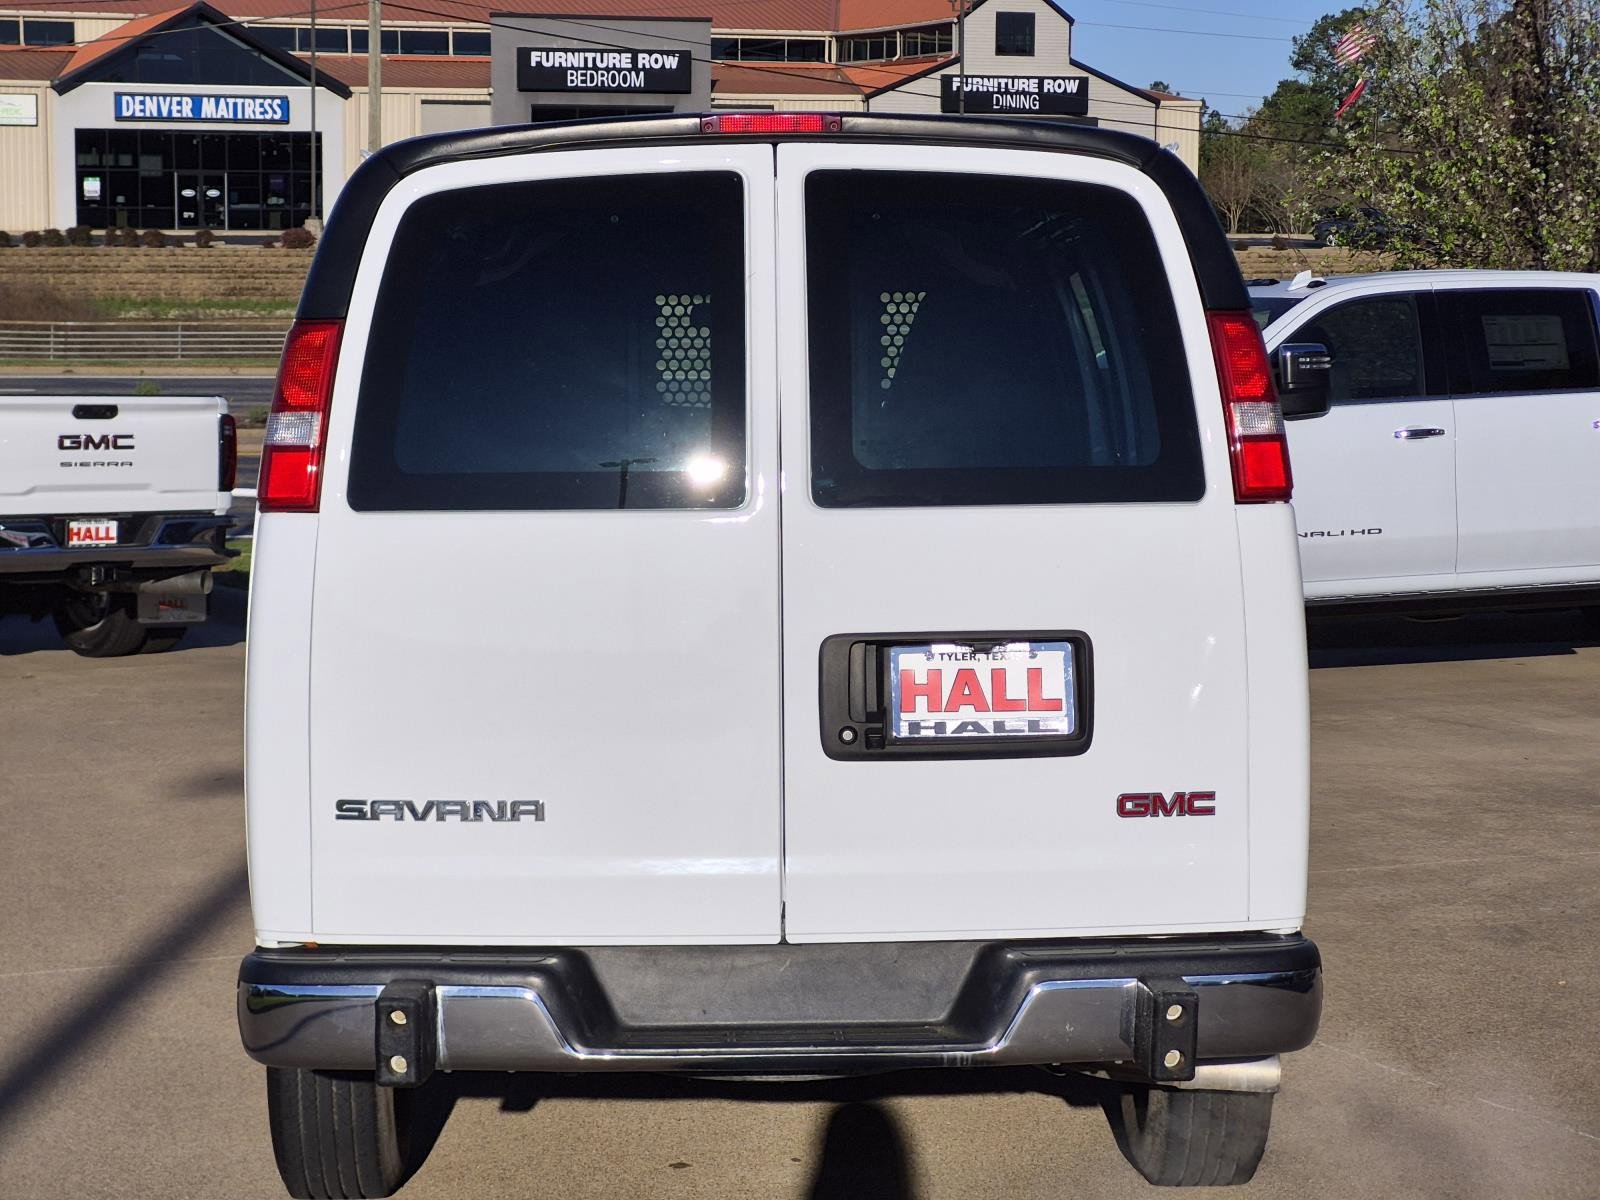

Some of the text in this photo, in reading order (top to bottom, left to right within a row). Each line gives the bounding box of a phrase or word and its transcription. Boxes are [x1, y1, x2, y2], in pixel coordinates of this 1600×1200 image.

[531, 51, 679, 70] FURNITURE ROW
[567, 70, 645, 88] BEDROOM
[952, 77, 1080, 94] FURNITURE ROW
[121, 95, 283, 120] DENVER MATTRESS
[992, 93, 1040, 110] DINING
[58, 434, 135, 450] GMC
[68, 526, 116, 541] HALL
[1350, 527, 1382, 536] HD
[900, 667, 1063, 713] HALL
[908, 719, 1060, 734] HALL
[335, 798, 546, 822] SAVANA
[1116, 790, 1216, 818] GMC
